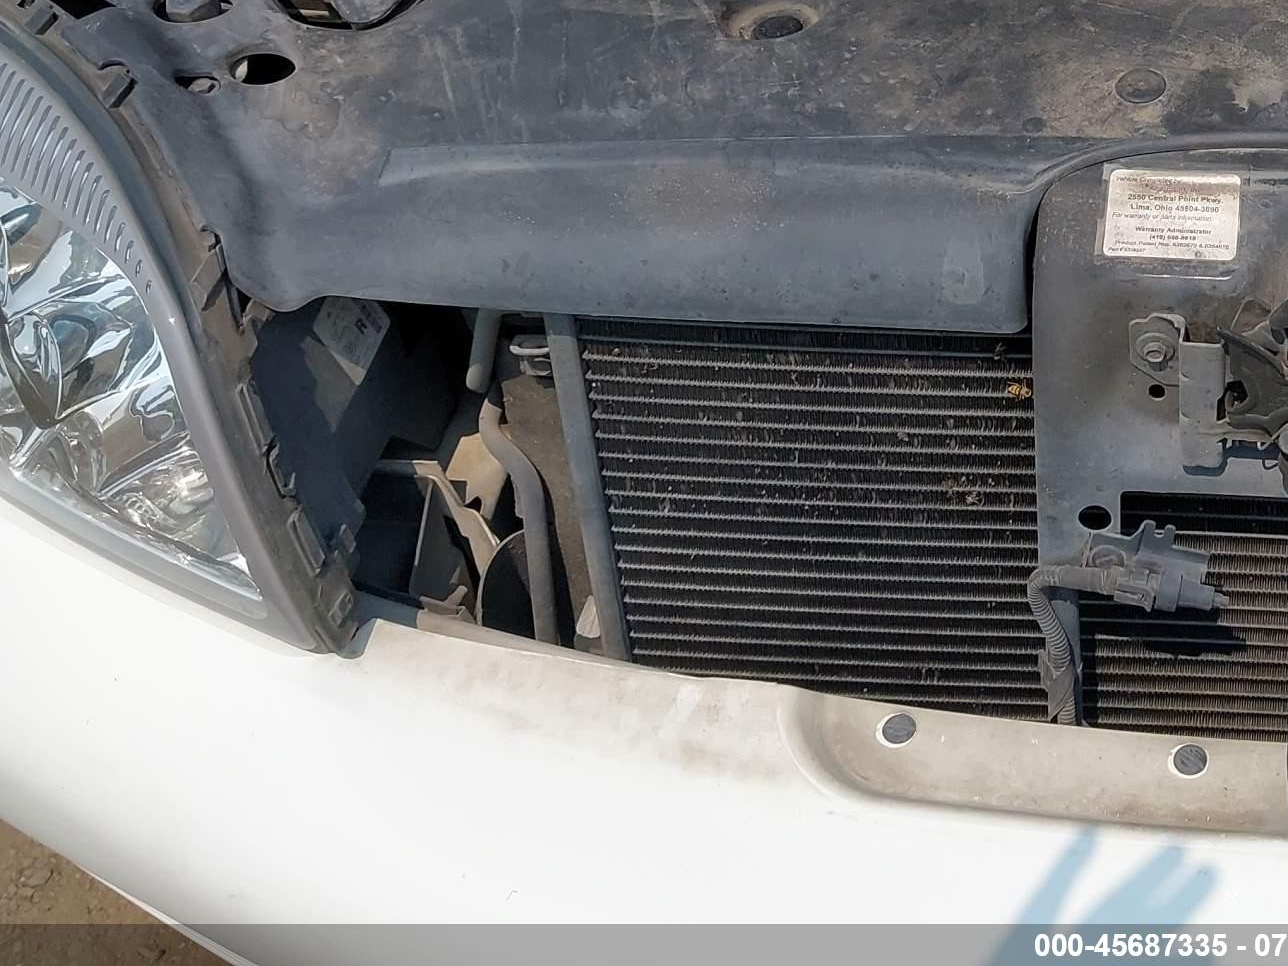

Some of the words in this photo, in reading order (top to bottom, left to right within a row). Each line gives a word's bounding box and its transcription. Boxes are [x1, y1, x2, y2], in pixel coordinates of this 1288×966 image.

[1148, 194, 1176, 202] Central
[1178, 195, 1199, 203] Point
[1201, 197, 1224, 205] Pkwy.
[1155, 204, 1173, 212] Ohio
[1136, 226, 1165, 234] Warranty
[1167, 227, 1212, 235] Administrator
